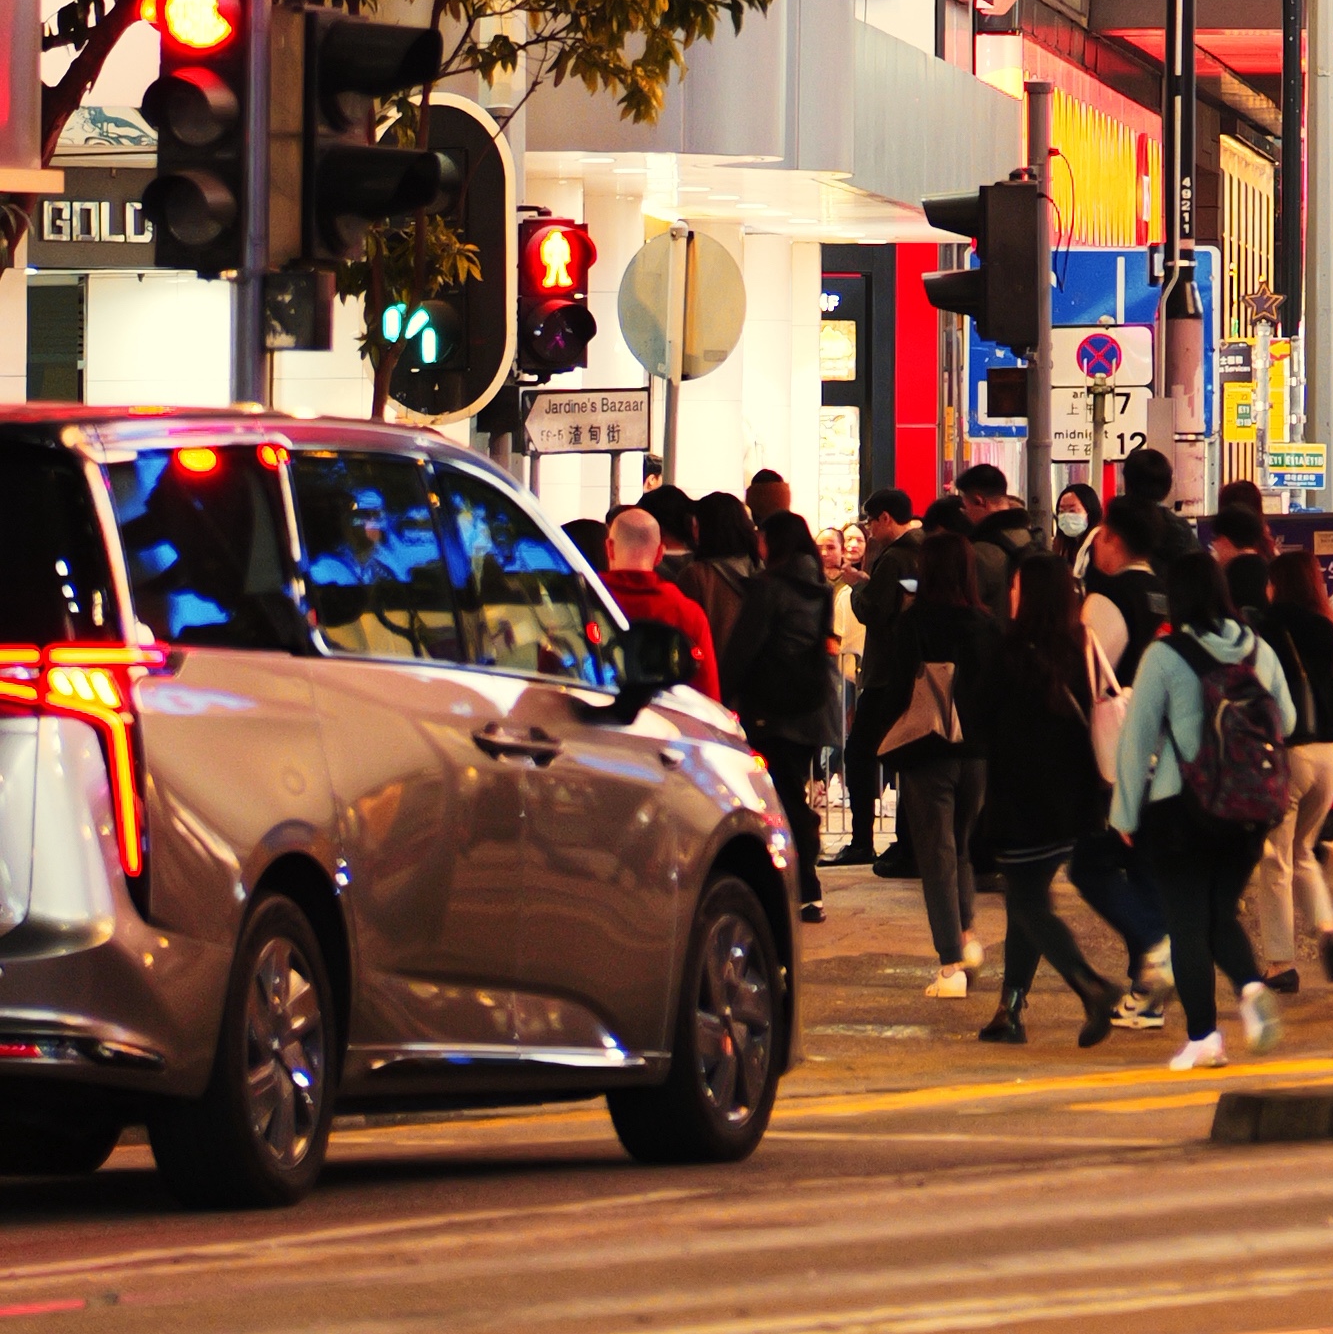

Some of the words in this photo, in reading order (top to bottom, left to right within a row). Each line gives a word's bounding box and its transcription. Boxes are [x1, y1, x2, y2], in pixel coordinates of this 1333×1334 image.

[1181, 176, 1192, 234] 49211
[43, 199, 154, 245] GOLD
[545, 396, 597, 414] Jardine's
[601, 396, 644, 413] Bazaar
[1116, 392, 1132, 415] 7
[568, 423, 622, 445] 渣甸街
[1116, 431, 1148, 456] 12
